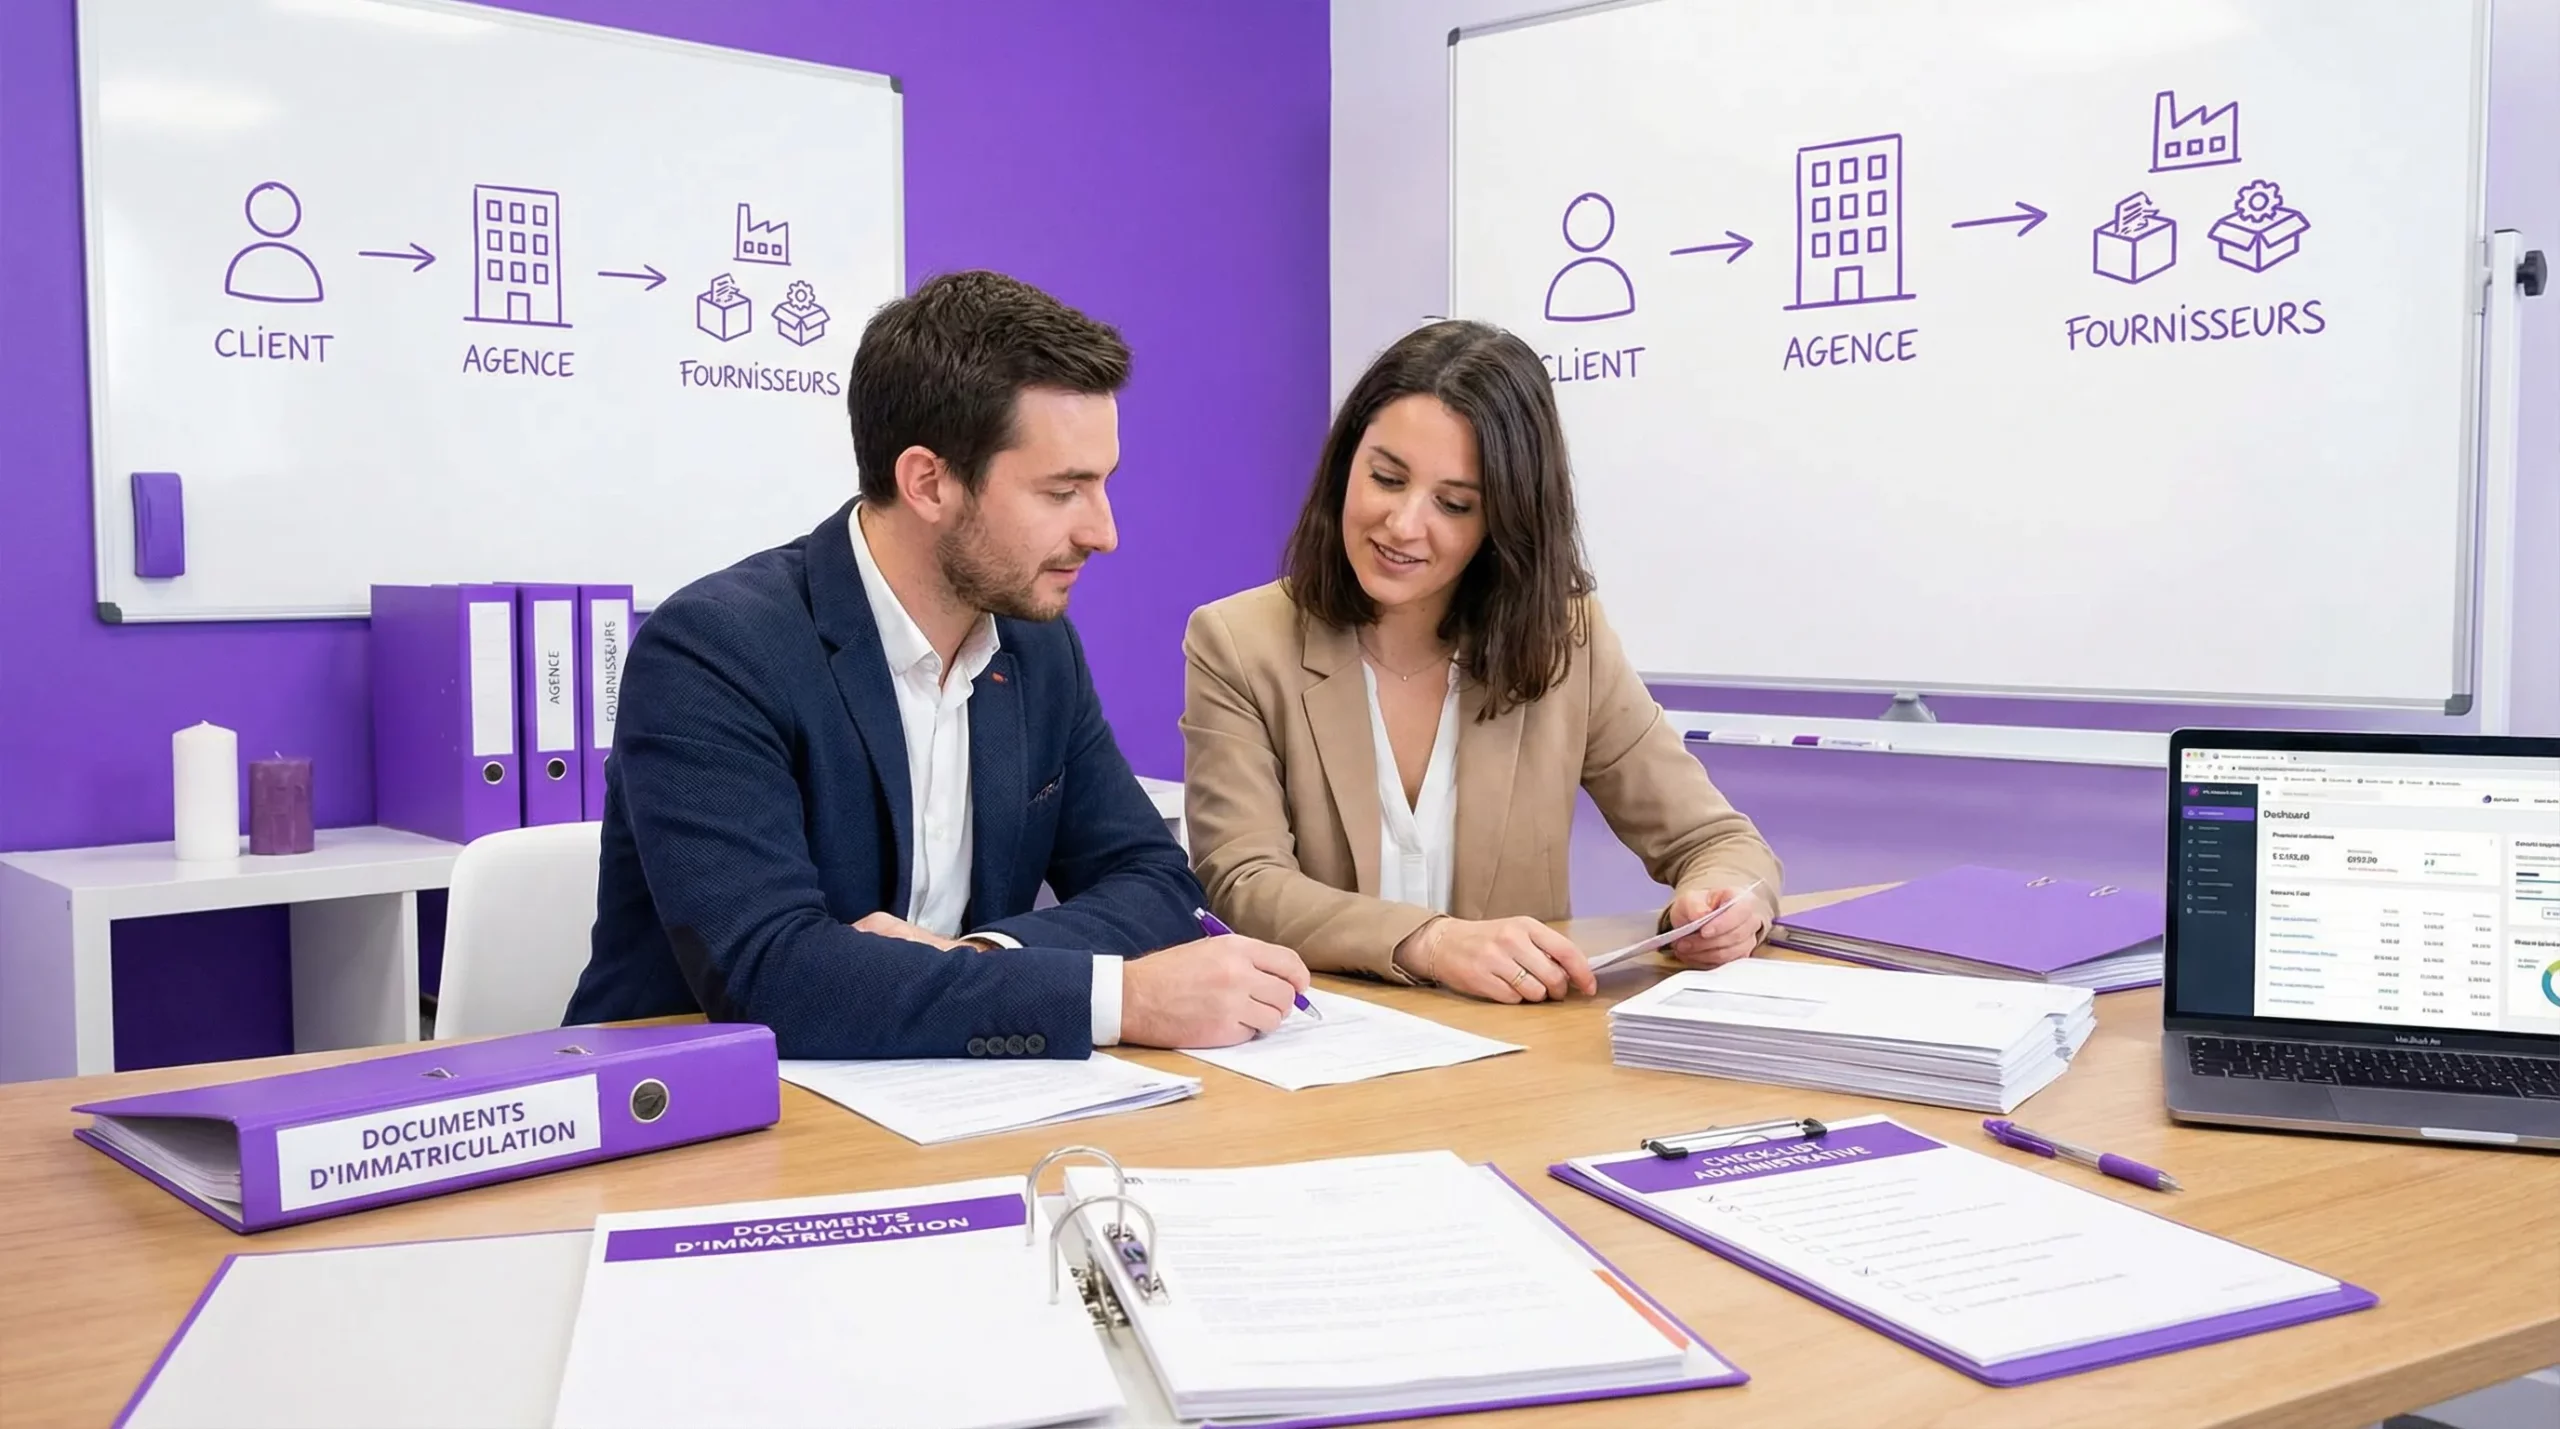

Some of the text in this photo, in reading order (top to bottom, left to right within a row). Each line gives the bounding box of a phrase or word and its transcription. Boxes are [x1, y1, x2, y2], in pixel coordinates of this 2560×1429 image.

[462, 344, 575, 378] AGENCE
[1782, 328, 1920, 371] AGENCE
[547, 650, 561, 706] AGENCE
[361, 1101, 526, 1150] DOCUMENTS
[310, 1119, 577, 1191] D'IMMATRICULATION
[1693, 1145, 1873, 1181] ADMINISTRATIVE
[1702, 1141, 1824, 1168] CHECK-LIST
[674, 1216, 970, 1254] D'IMMATRICULATION
[732, 1210, 911, 1238] DOCUMENTS
